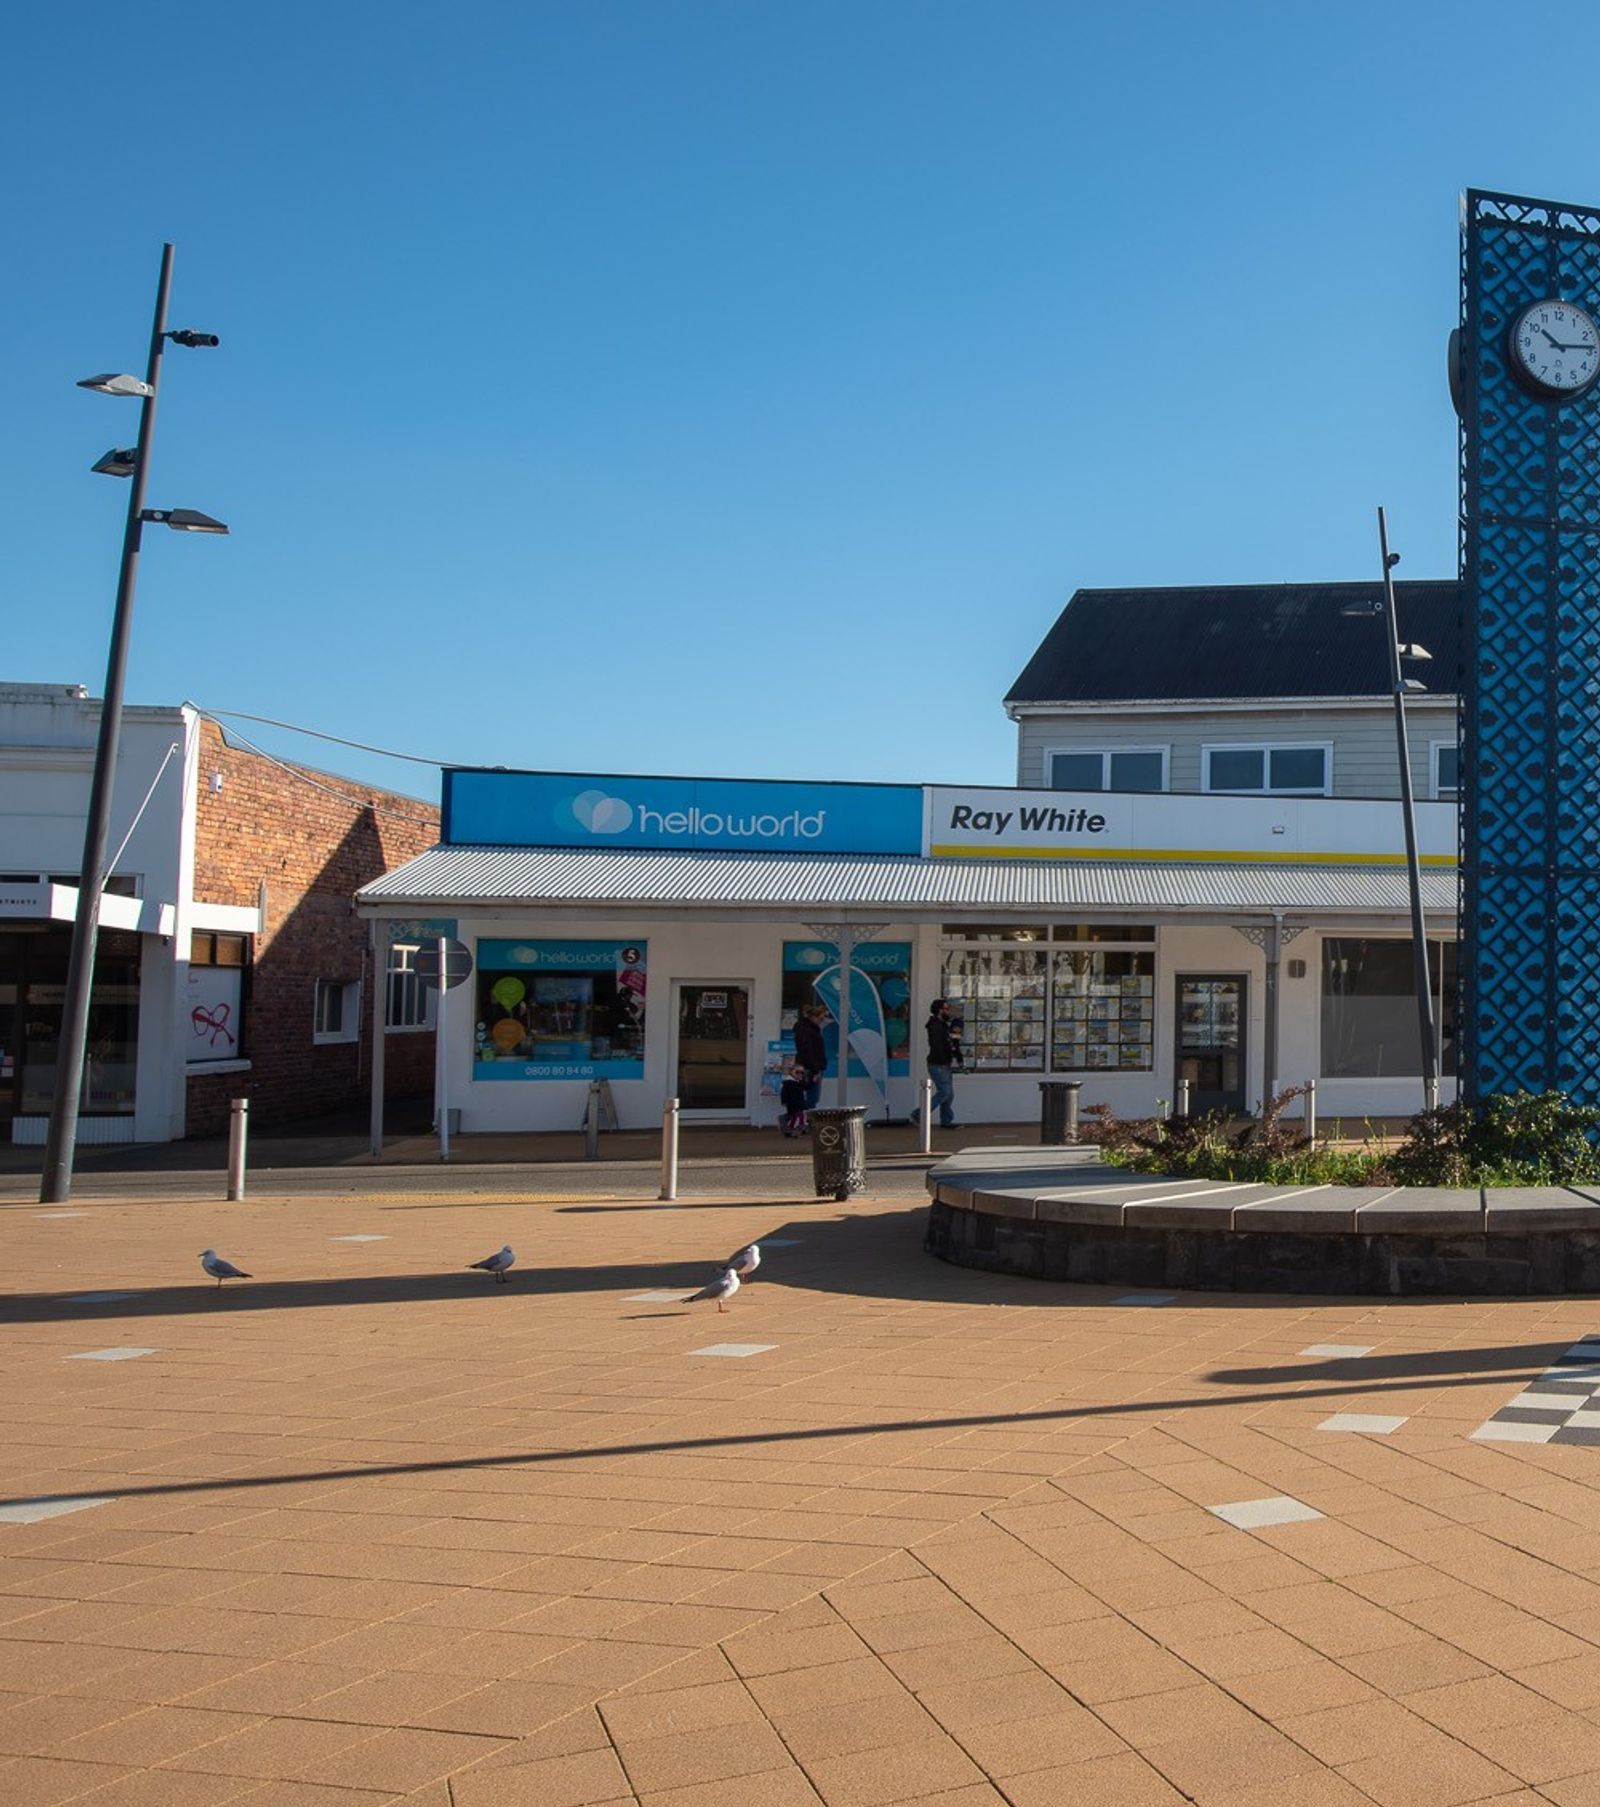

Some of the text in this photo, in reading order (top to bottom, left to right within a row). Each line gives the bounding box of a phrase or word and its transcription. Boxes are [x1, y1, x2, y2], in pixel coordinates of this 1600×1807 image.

[1541, 313, 1549, 324] 11
[1554, 311, 1565, 321] 12
[1529, 323, 1540, 333] 10
[1572, 318, 1576, 328] 1
[1582, 331, 1589, 341] 2
[1524, 337, 1531, 347] 9
[1585, 346, 1593, 356] 3
[1529, 353, 1536, 363] 8
[1541, 366, 1548, 375] 7
[1580, 361, 1587, 371] 4
[1555, 372, 1561, 382] 6
[1570, 370, 1577, 379] 5
[638, 804, 826, 839] helloworld
[950, 805, 1106, 835] Ray White
[540, 951, 618, 964] helloworld
[827, 952, 899, 965] howorld
